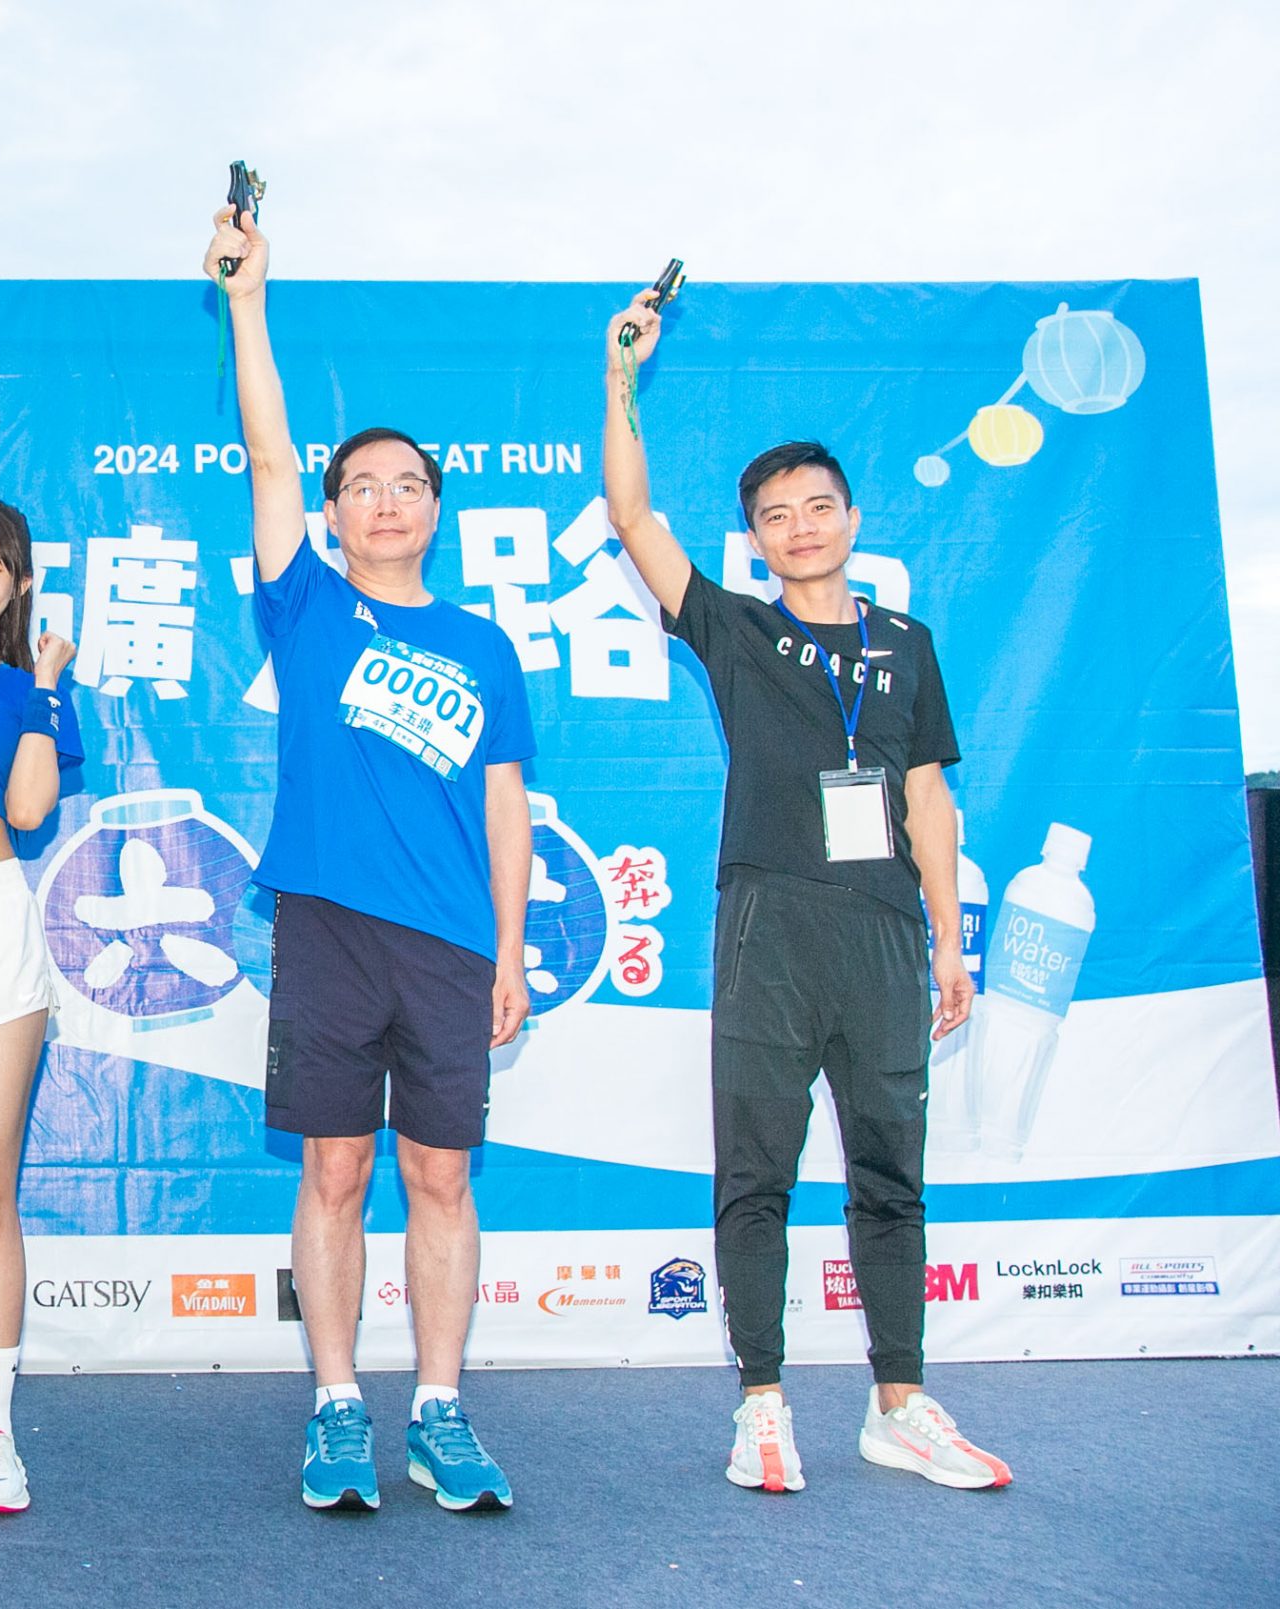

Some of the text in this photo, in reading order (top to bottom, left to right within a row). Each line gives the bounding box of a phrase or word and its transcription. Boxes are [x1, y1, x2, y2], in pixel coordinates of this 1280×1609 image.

[93, 444, 180, 475] 2024
[500, 443, 582, 475] RUN
[776, 636, 893, 694] COACH
[362, 658, 478, 739] 00001
[74, 837, 240, 988] 六
[1007, 908, 1044, 943] ion
[1003, 932, 1073, 974] water
[924, 1263, 980, 1303] 3M
[996, 1259, 1103, 1277] LocknLock
[32, 1279, 152, 1313] GATSBY
[555, 1294, 626, 1307] Momentum
[1022, 1283, 1083, 1300] 樂扣樂扣
